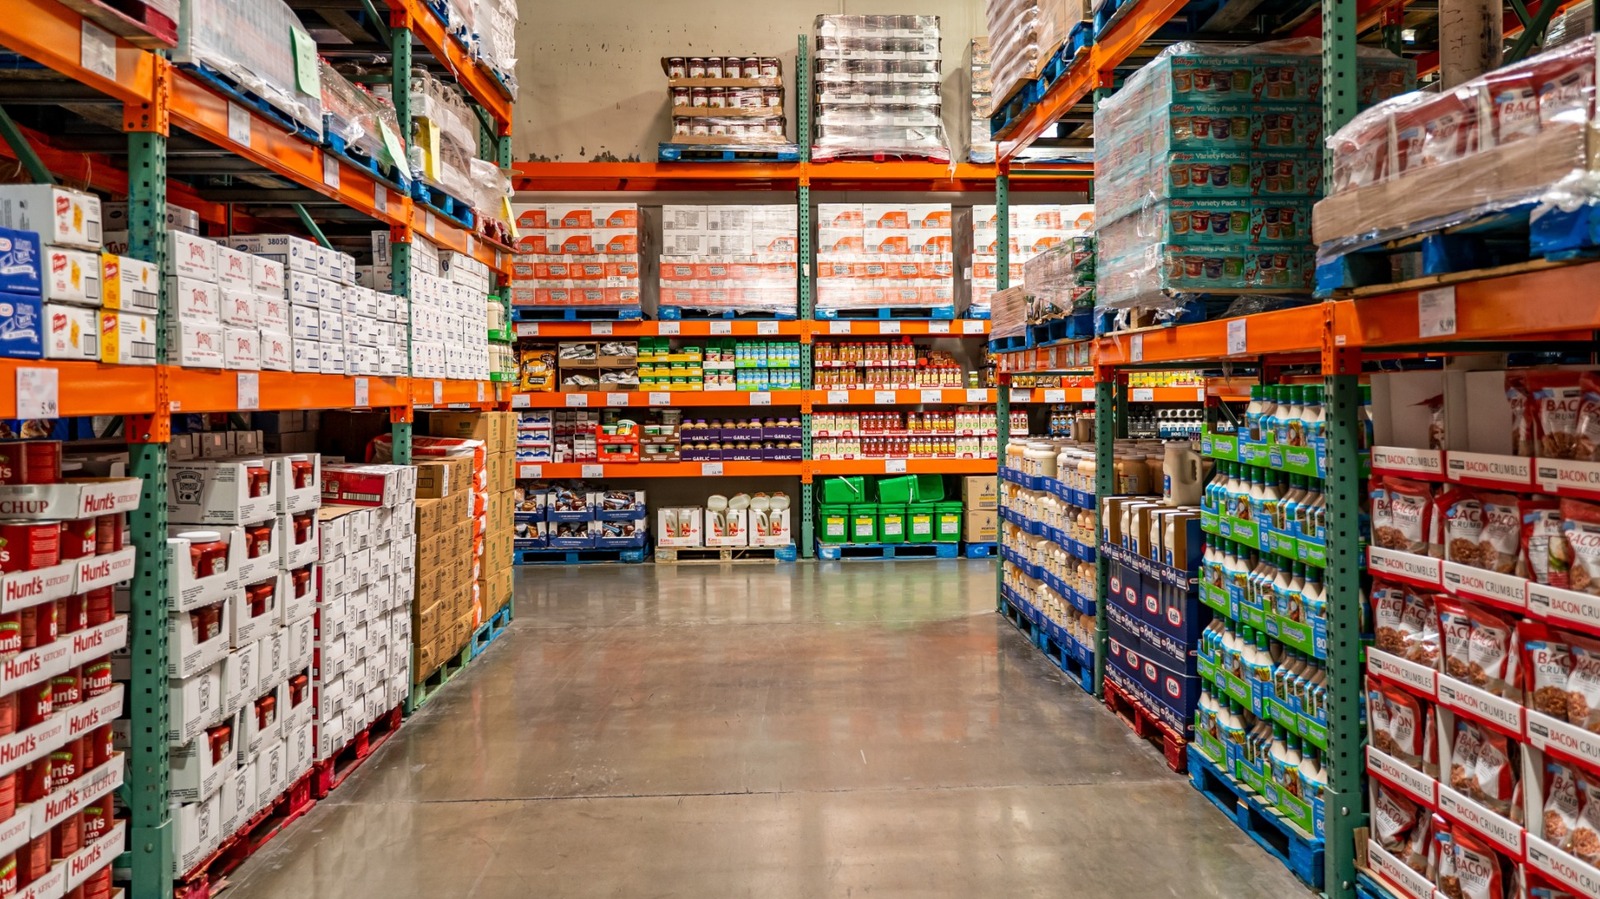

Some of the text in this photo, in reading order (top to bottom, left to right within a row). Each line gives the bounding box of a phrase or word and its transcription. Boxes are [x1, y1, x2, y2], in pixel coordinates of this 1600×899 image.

[1196, 200, 1222, 208] Variety
[268, 238, 288, 246] 38050
[1388, 455, 1406, 465] BACON
[1406, 456, 1439, 468] CRUMBLES
[1466, 461, 1489, 473] BACON
[1489, 463, 1528, 477] CRUMBLES
[1559, 470, 1588, 483] BACON
[84, 492, 116, 513] Hunt's
[81, 560, 110, 583] Hunt's
[1385, 558, 1438, 579] BACON CRUMBLES
[6, 576, 43, 601] Hunt's
[1461, 575, 1524, 600] BACON CRUMBLES
[1552, 599, 1580, 615] BACON
[74, 628, 103, 654] Hunt's
[4, 652, 41, 681] Hunt's
[1382, 660, 1433, 689] BACON CRUMBLES
[70, 707, 99, 736] Hunt's
[1456, 693, 1518, 727] BACON CRUMBLES
[0, 733, 36, 765] Hunt's
[1550, 732, 1579, 750] BACON
[1381, 763, 1432, 797] BACON CRUMBLES
[45, 770, 118, 823] Hunt's KETCHUP
[1456, 804, 1518, 847] BACON CRUMBLES
[72, 844, 101, 877] Hunt's
[1382, 860, 1401, 879] BACON
[1456, 858, 1490, 879] BACON
[1550, 858, 1578, 882] BACON
